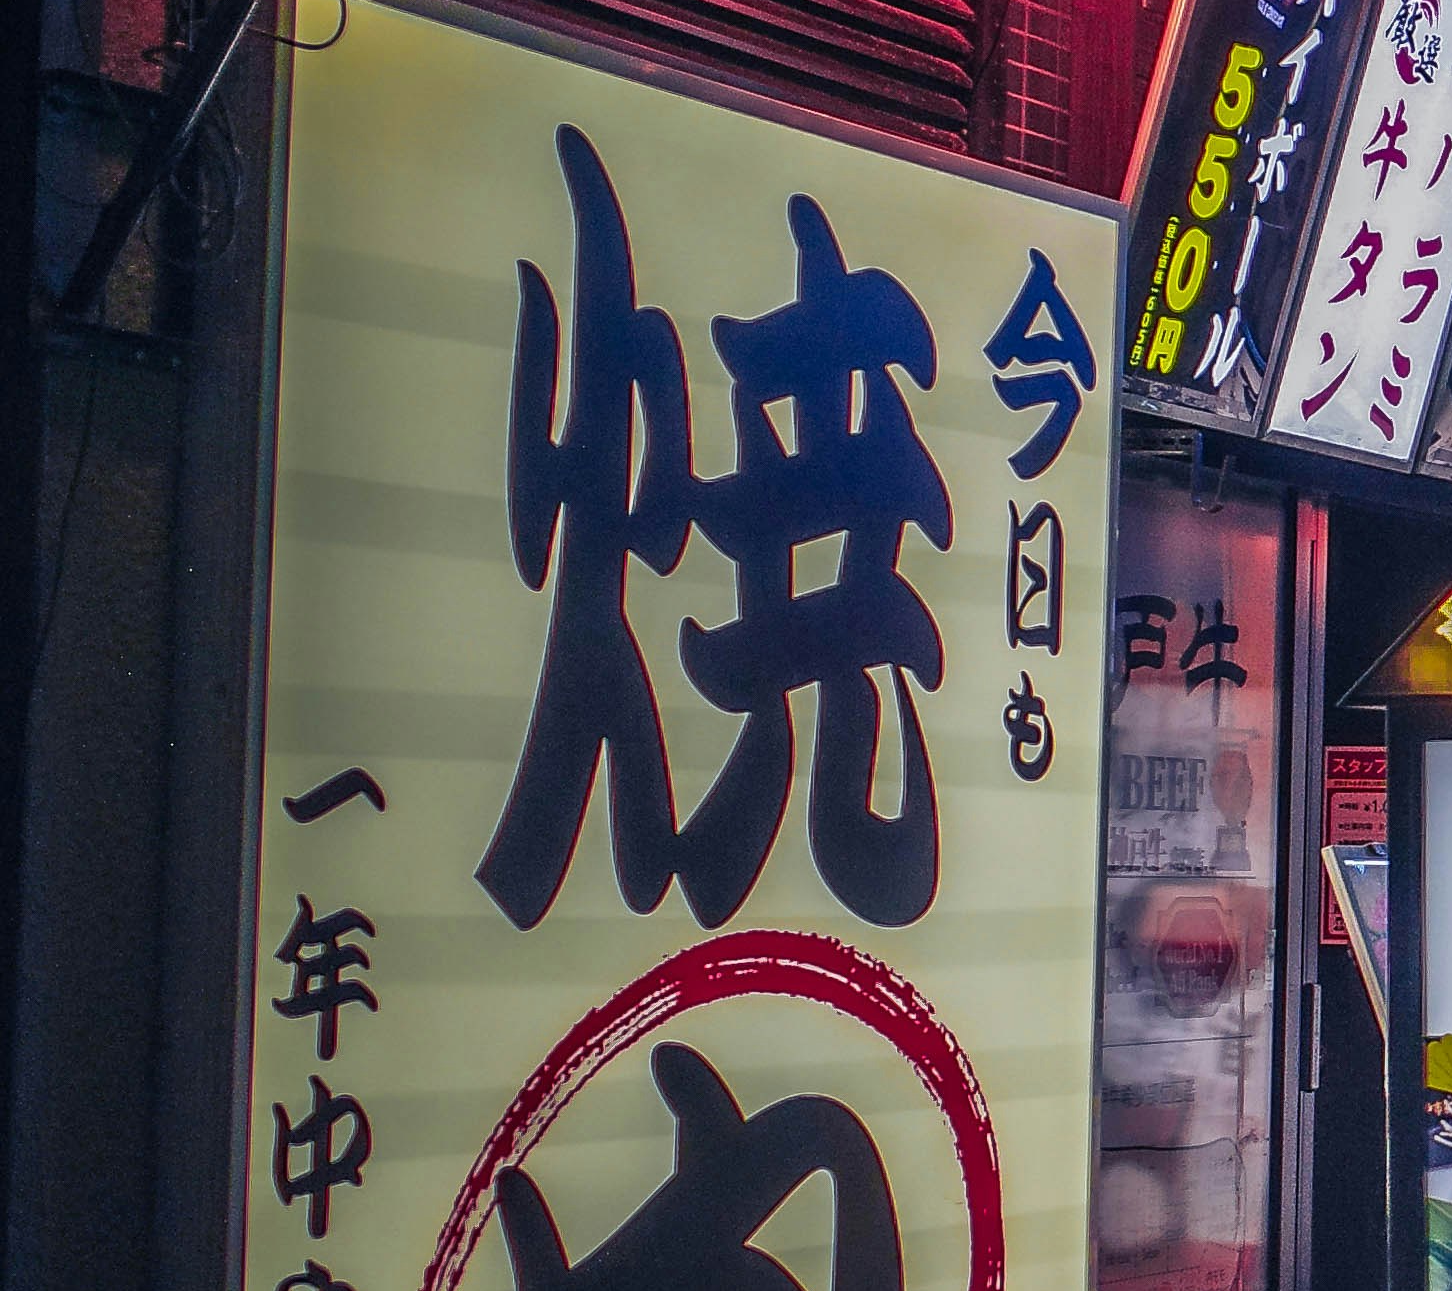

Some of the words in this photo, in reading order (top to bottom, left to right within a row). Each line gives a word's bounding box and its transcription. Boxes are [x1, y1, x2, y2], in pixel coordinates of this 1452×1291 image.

[1146, 42, 1264, 375] 550円
[1302, 99, 1409, 422] 牛タン
[983, 246, 1097, 782] 今日も
[1121, 754, 1207, 813] BEEF
